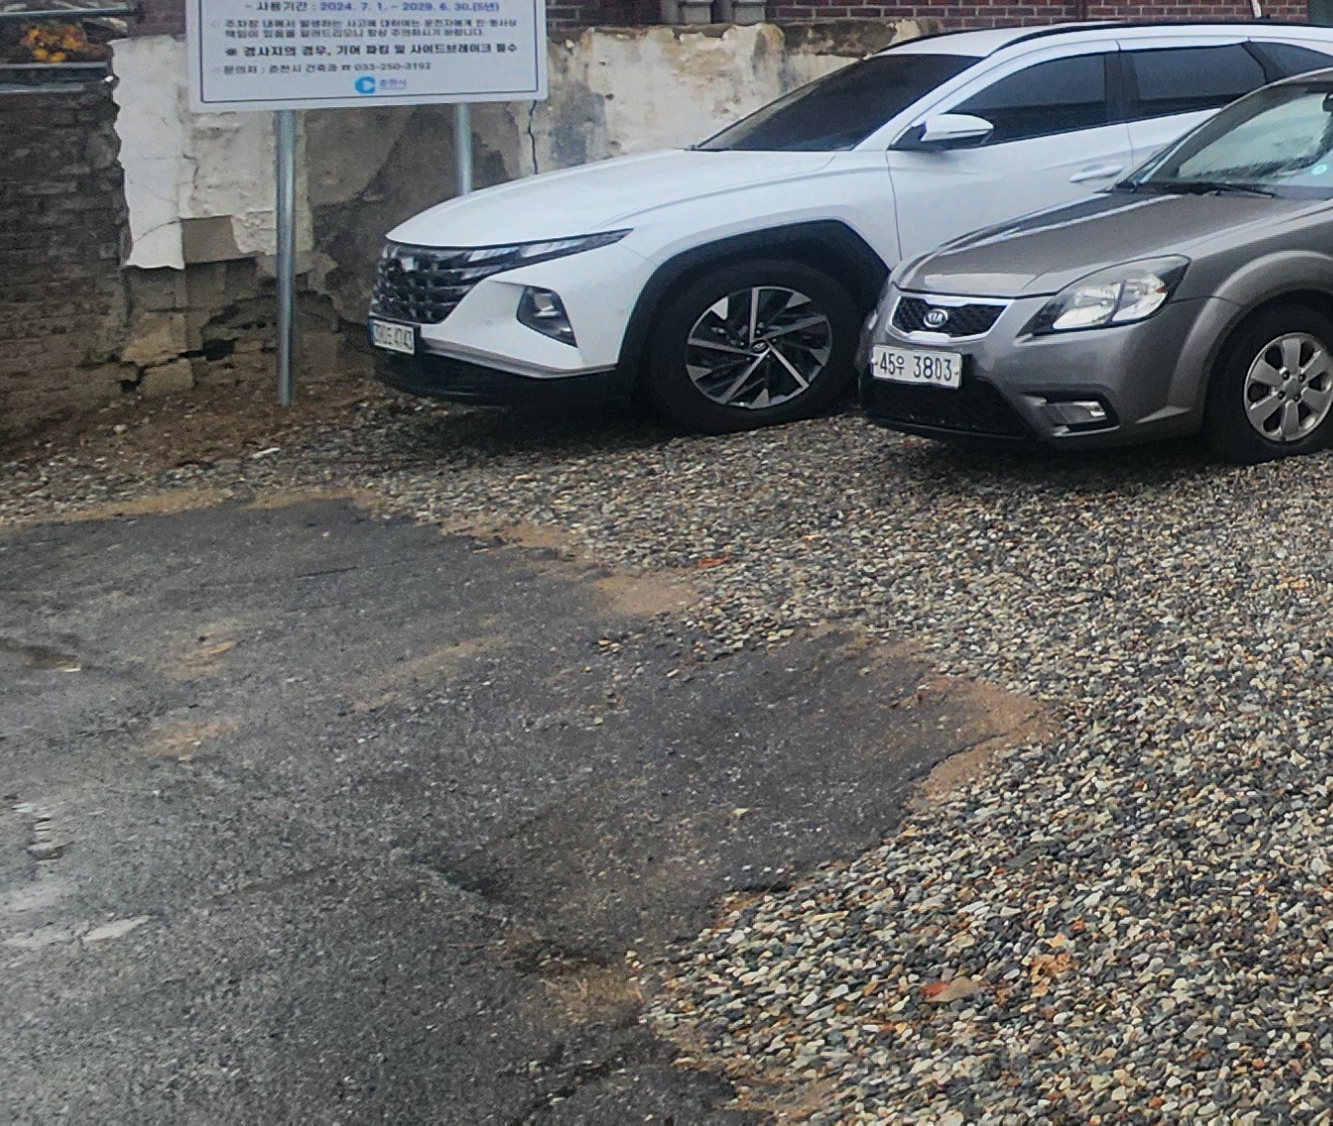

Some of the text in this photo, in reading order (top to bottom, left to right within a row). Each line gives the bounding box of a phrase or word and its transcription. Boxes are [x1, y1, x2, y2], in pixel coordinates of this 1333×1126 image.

[257, 1, 307, 11] 사용기간
[320, 1, 355, 11] 2024.
[243, 43, 517, 56] 경사지의 경우, 기어 파킹 및 사이드브레이크 필수
[269, 64, 301, 73] 춘천시
[306, 63, 337, 72] 건축과
[880, 352, 952, 382] 45우 3803
